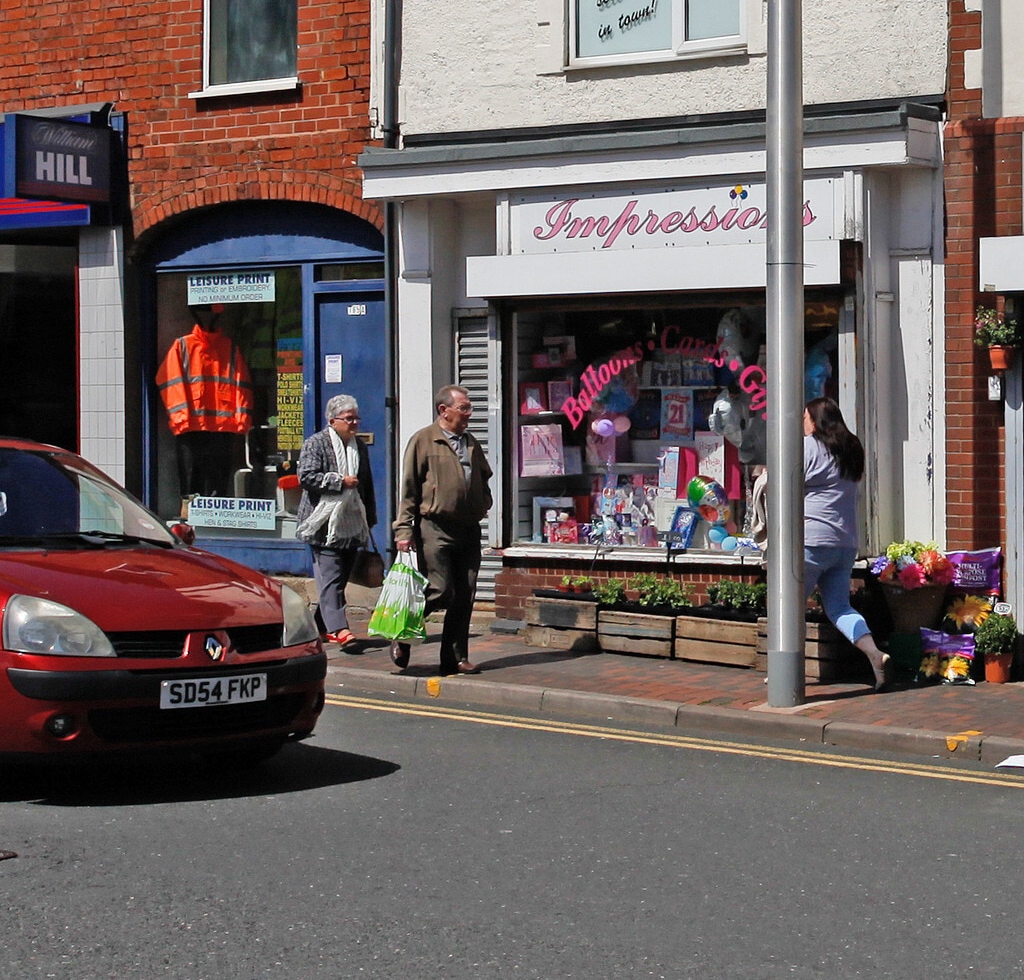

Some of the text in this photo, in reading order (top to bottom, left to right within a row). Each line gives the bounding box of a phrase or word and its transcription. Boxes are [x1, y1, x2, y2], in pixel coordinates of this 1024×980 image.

[598, 24, 612, 39] in
[35, 150, 92, 186] HILL
[533, 198, 817, 249] Impressios
[190, 272, 271, 287] LEISURE PRINT
[560, 325, 729, 430] Balloons Cards
[191, 499, 272, 511] LEISURE PRINT
[169, 677, 261, 704] SD54 FKP
